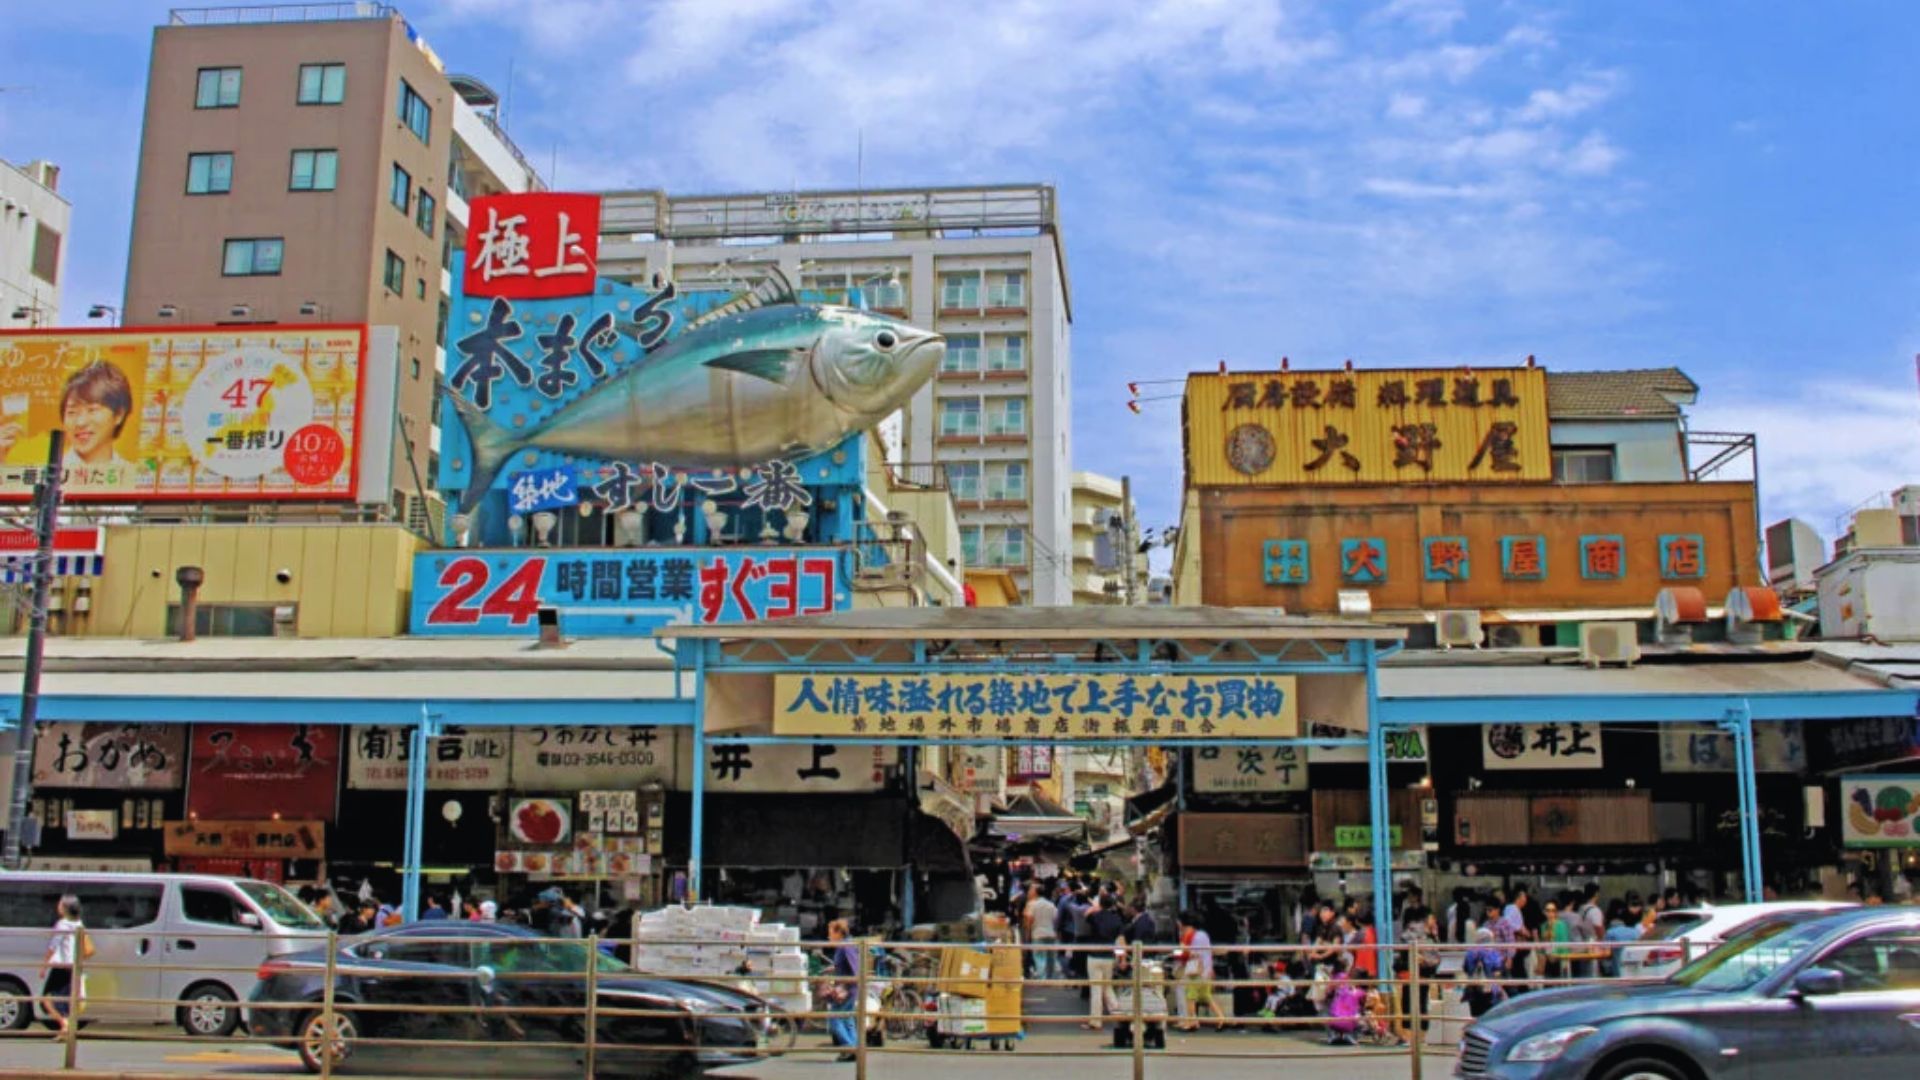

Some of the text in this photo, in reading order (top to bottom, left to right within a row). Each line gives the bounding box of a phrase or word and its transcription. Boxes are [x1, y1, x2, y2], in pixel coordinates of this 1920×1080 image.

[471, 207, 589, 281] 極上
[450, 282, 677, 411] 本まぐろ
[220, 377, 275, 408] 47
[206, 430, 284, 450] 一番搾り
[1303, 422, 1522, 472] 大野屋
[511, 470, 578, 512] 築地
[592, 462, 813, 513] すし一番
[787, 677, 1284, 720] 人情味溢れる築地で上手なお買物
[53, 731, 166, 773] おかめ
